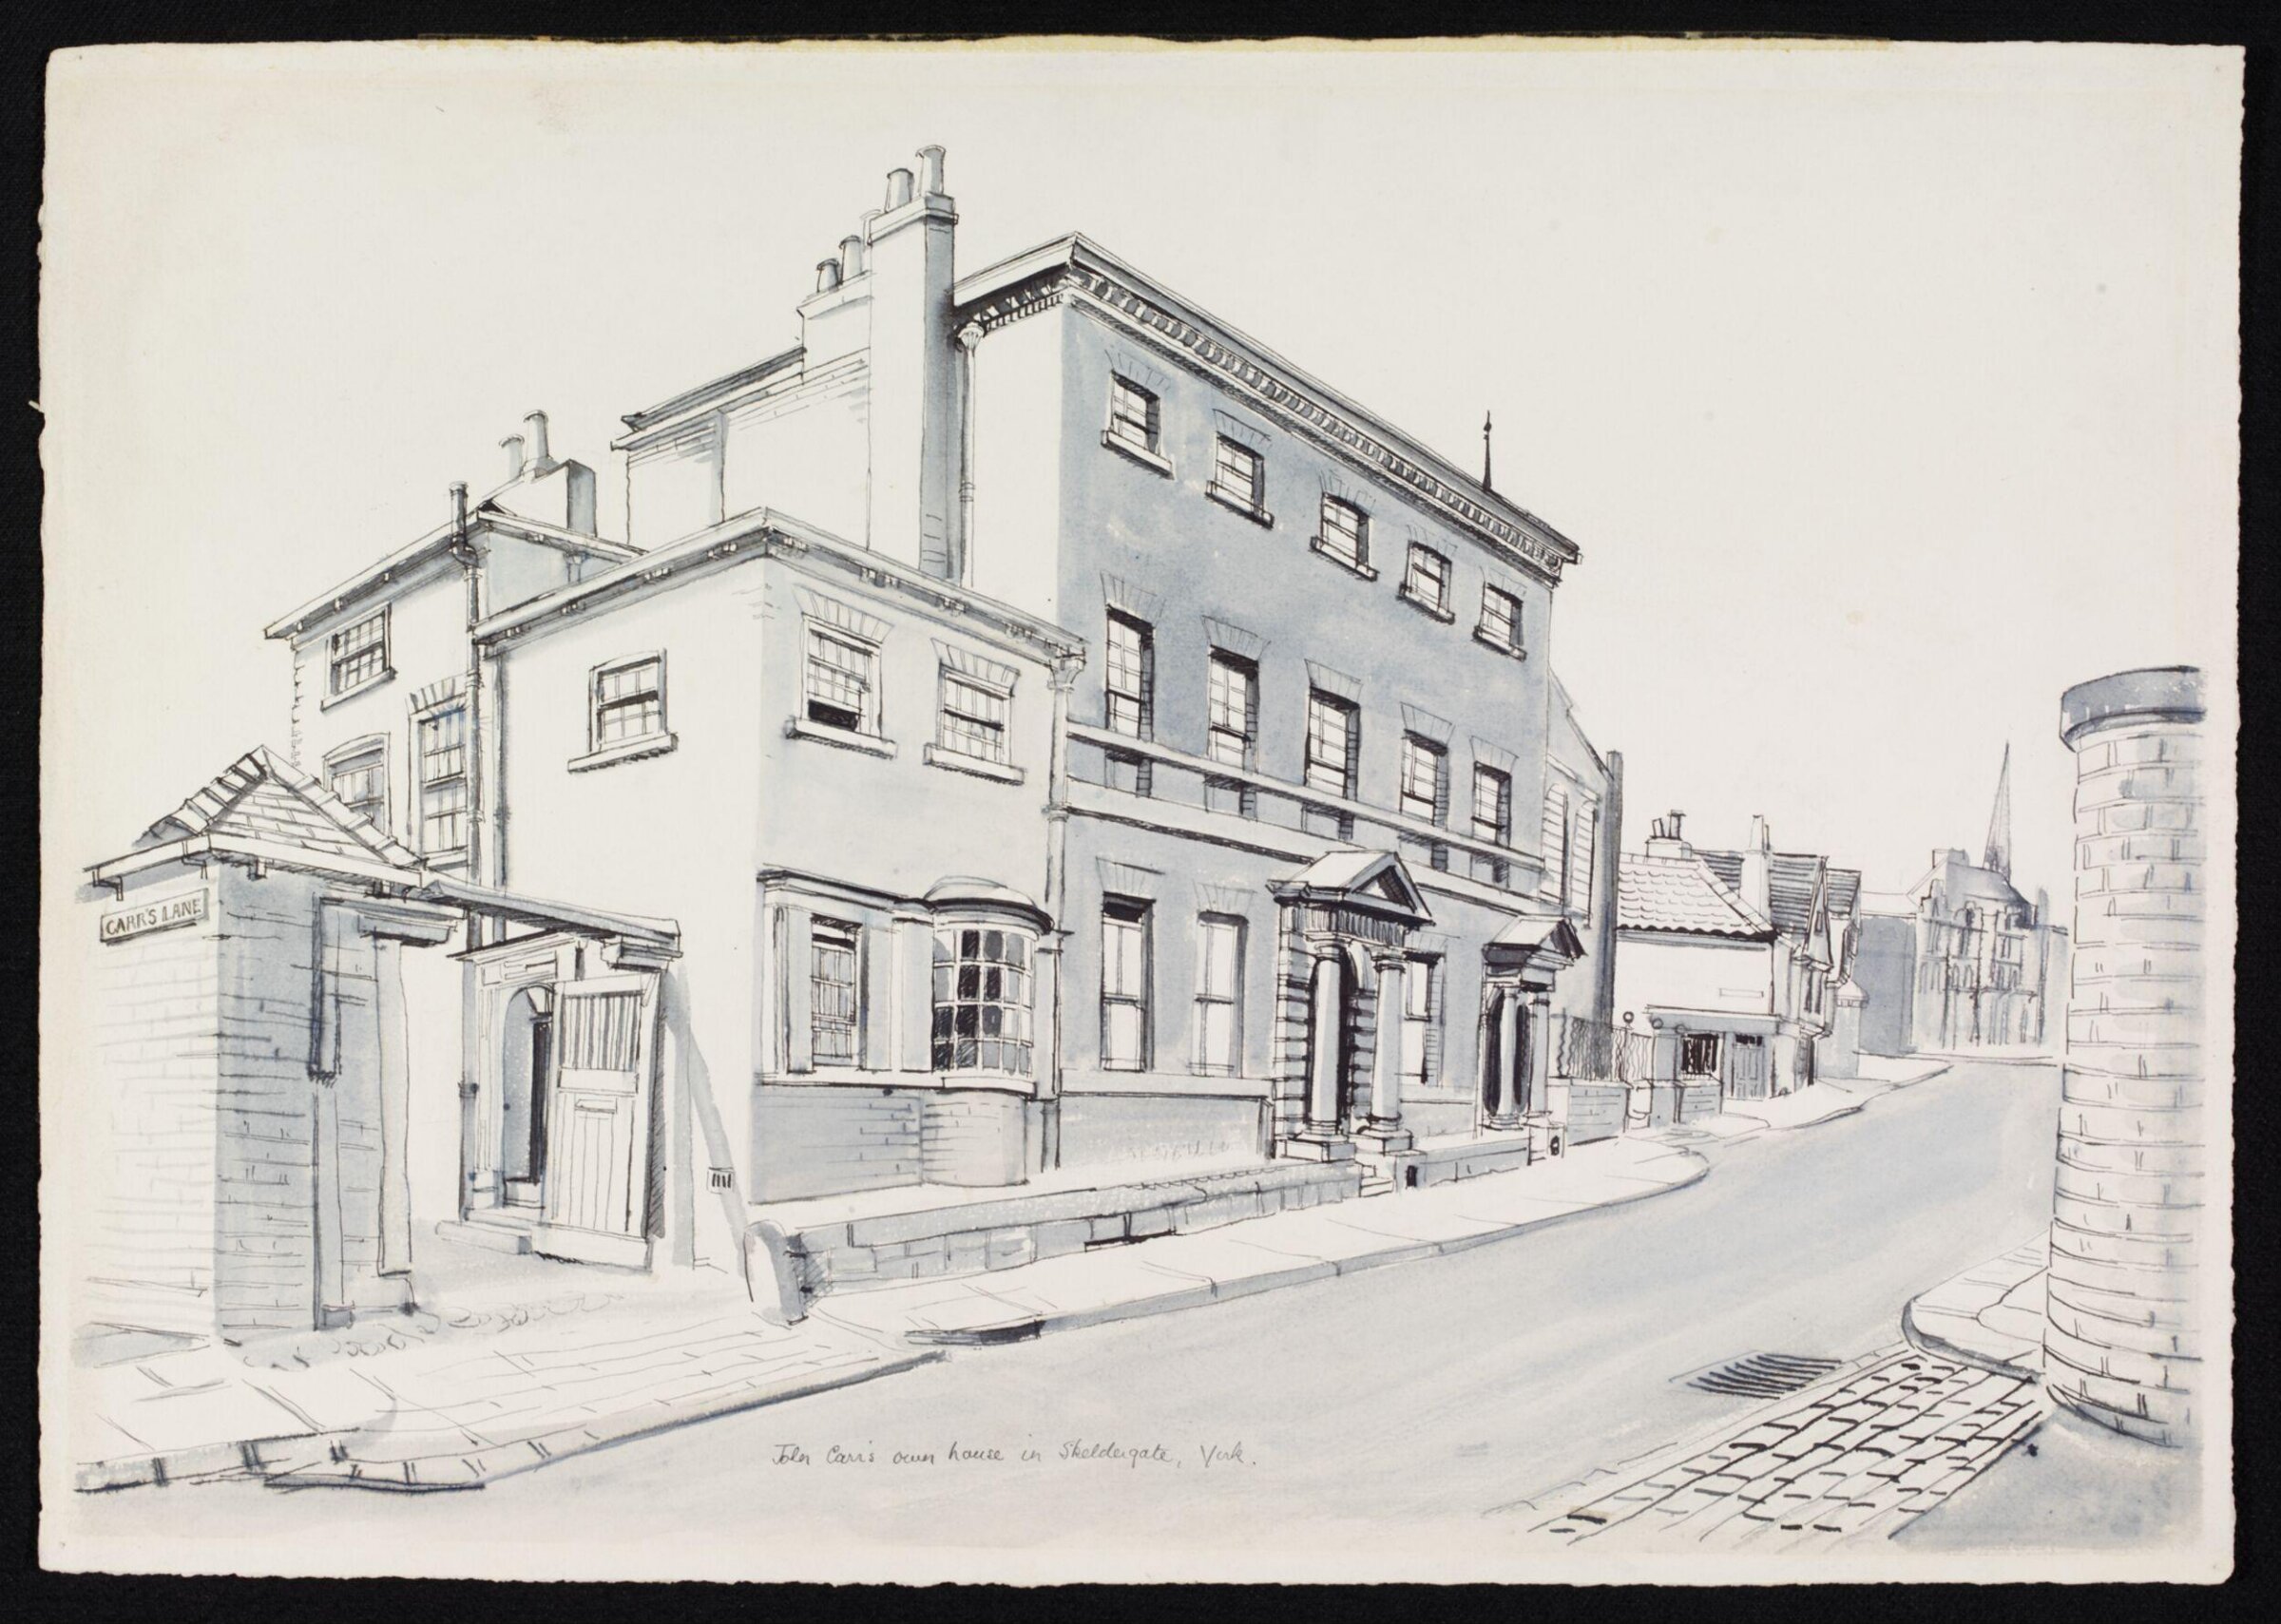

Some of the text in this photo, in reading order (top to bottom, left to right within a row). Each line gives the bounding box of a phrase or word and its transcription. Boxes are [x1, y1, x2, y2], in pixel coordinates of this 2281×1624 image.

[105, 898, 201, 935] CARR'S LANE
[772, 1443, 810, 1465] John
[825, 1440, 875, 1464] Carr's
[892, 1450, 934, 1465] own
[948, 1441, 1005, 1462] house
[1021, 1433, 1042, 1462] in
